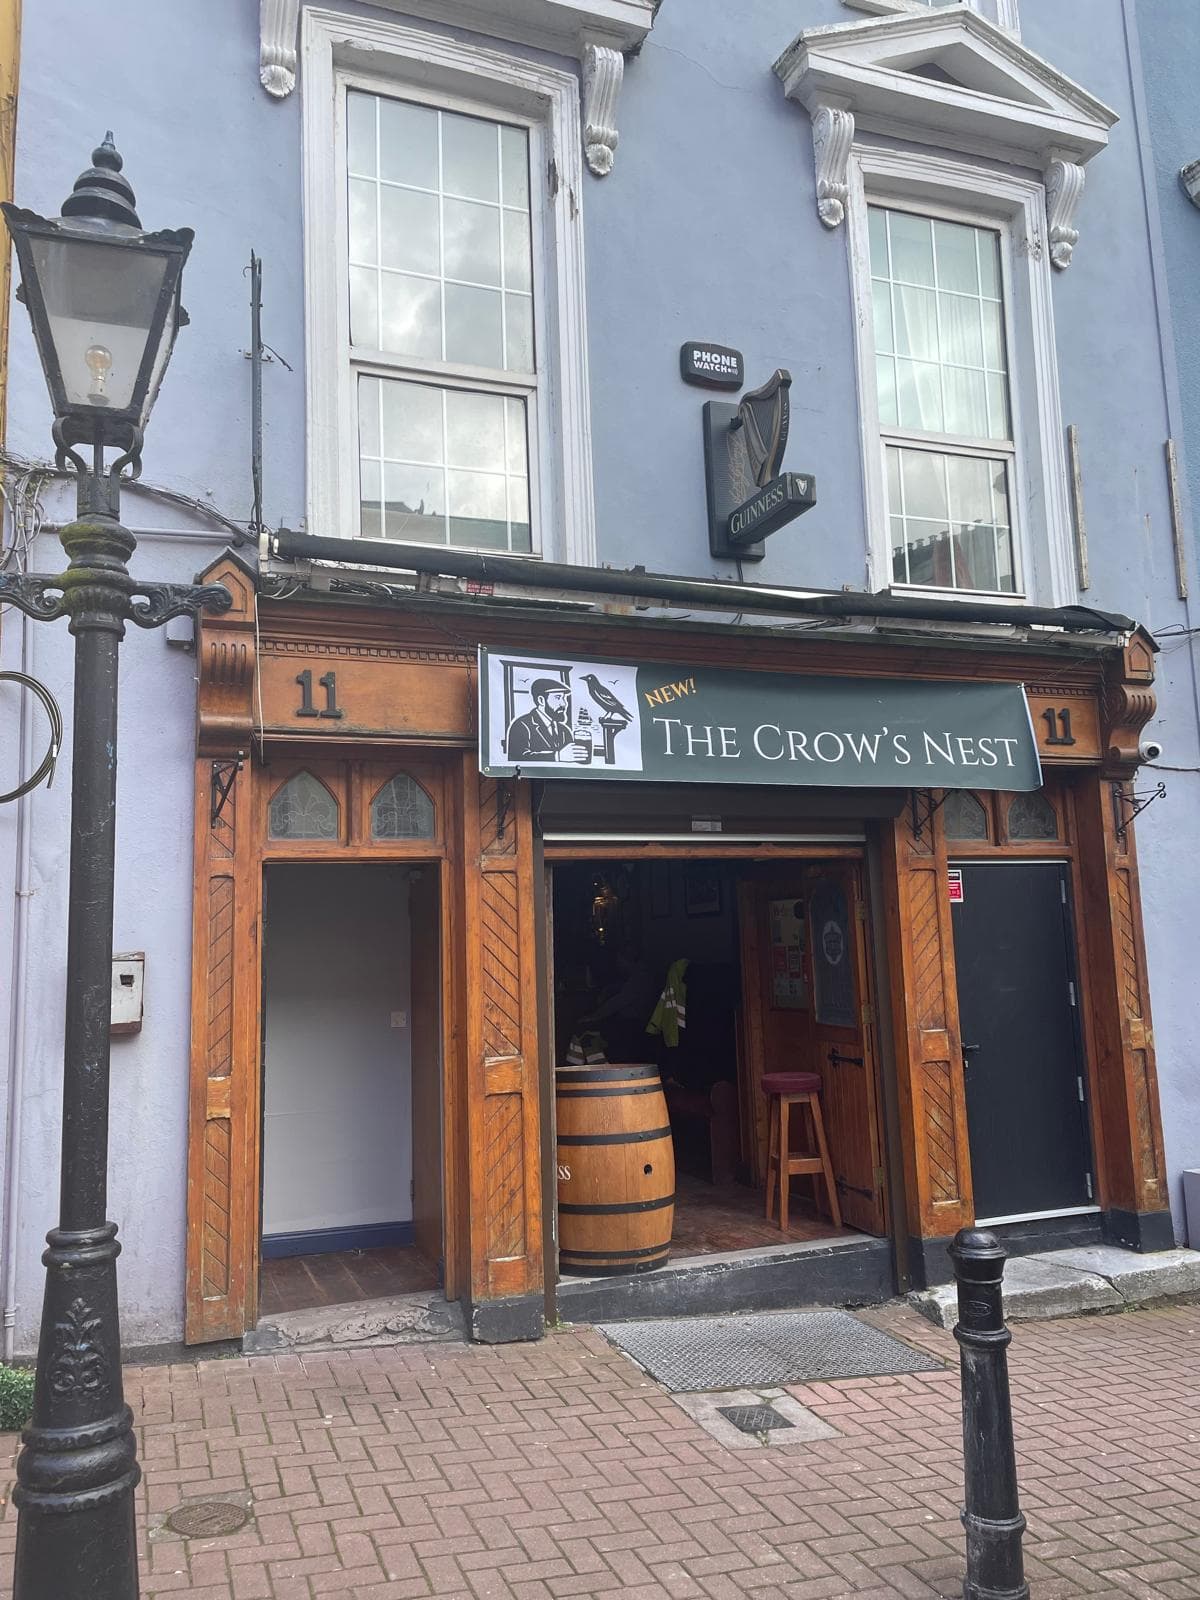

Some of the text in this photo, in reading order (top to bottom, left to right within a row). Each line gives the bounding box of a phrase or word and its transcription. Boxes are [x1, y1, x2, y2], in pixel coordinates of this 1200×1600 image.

[693, 350, 738, 368] PHONE
[693, 361, 727, 373] WATCH
[730, 484, 784, 534] GUINNESS
[296, 669, 343, 719] 11
[644, 678, 697, 708] NEW!
[652, 717, 1018, 767] THE CROW'S NEST
[1042, 707, 1076, 746] 11
